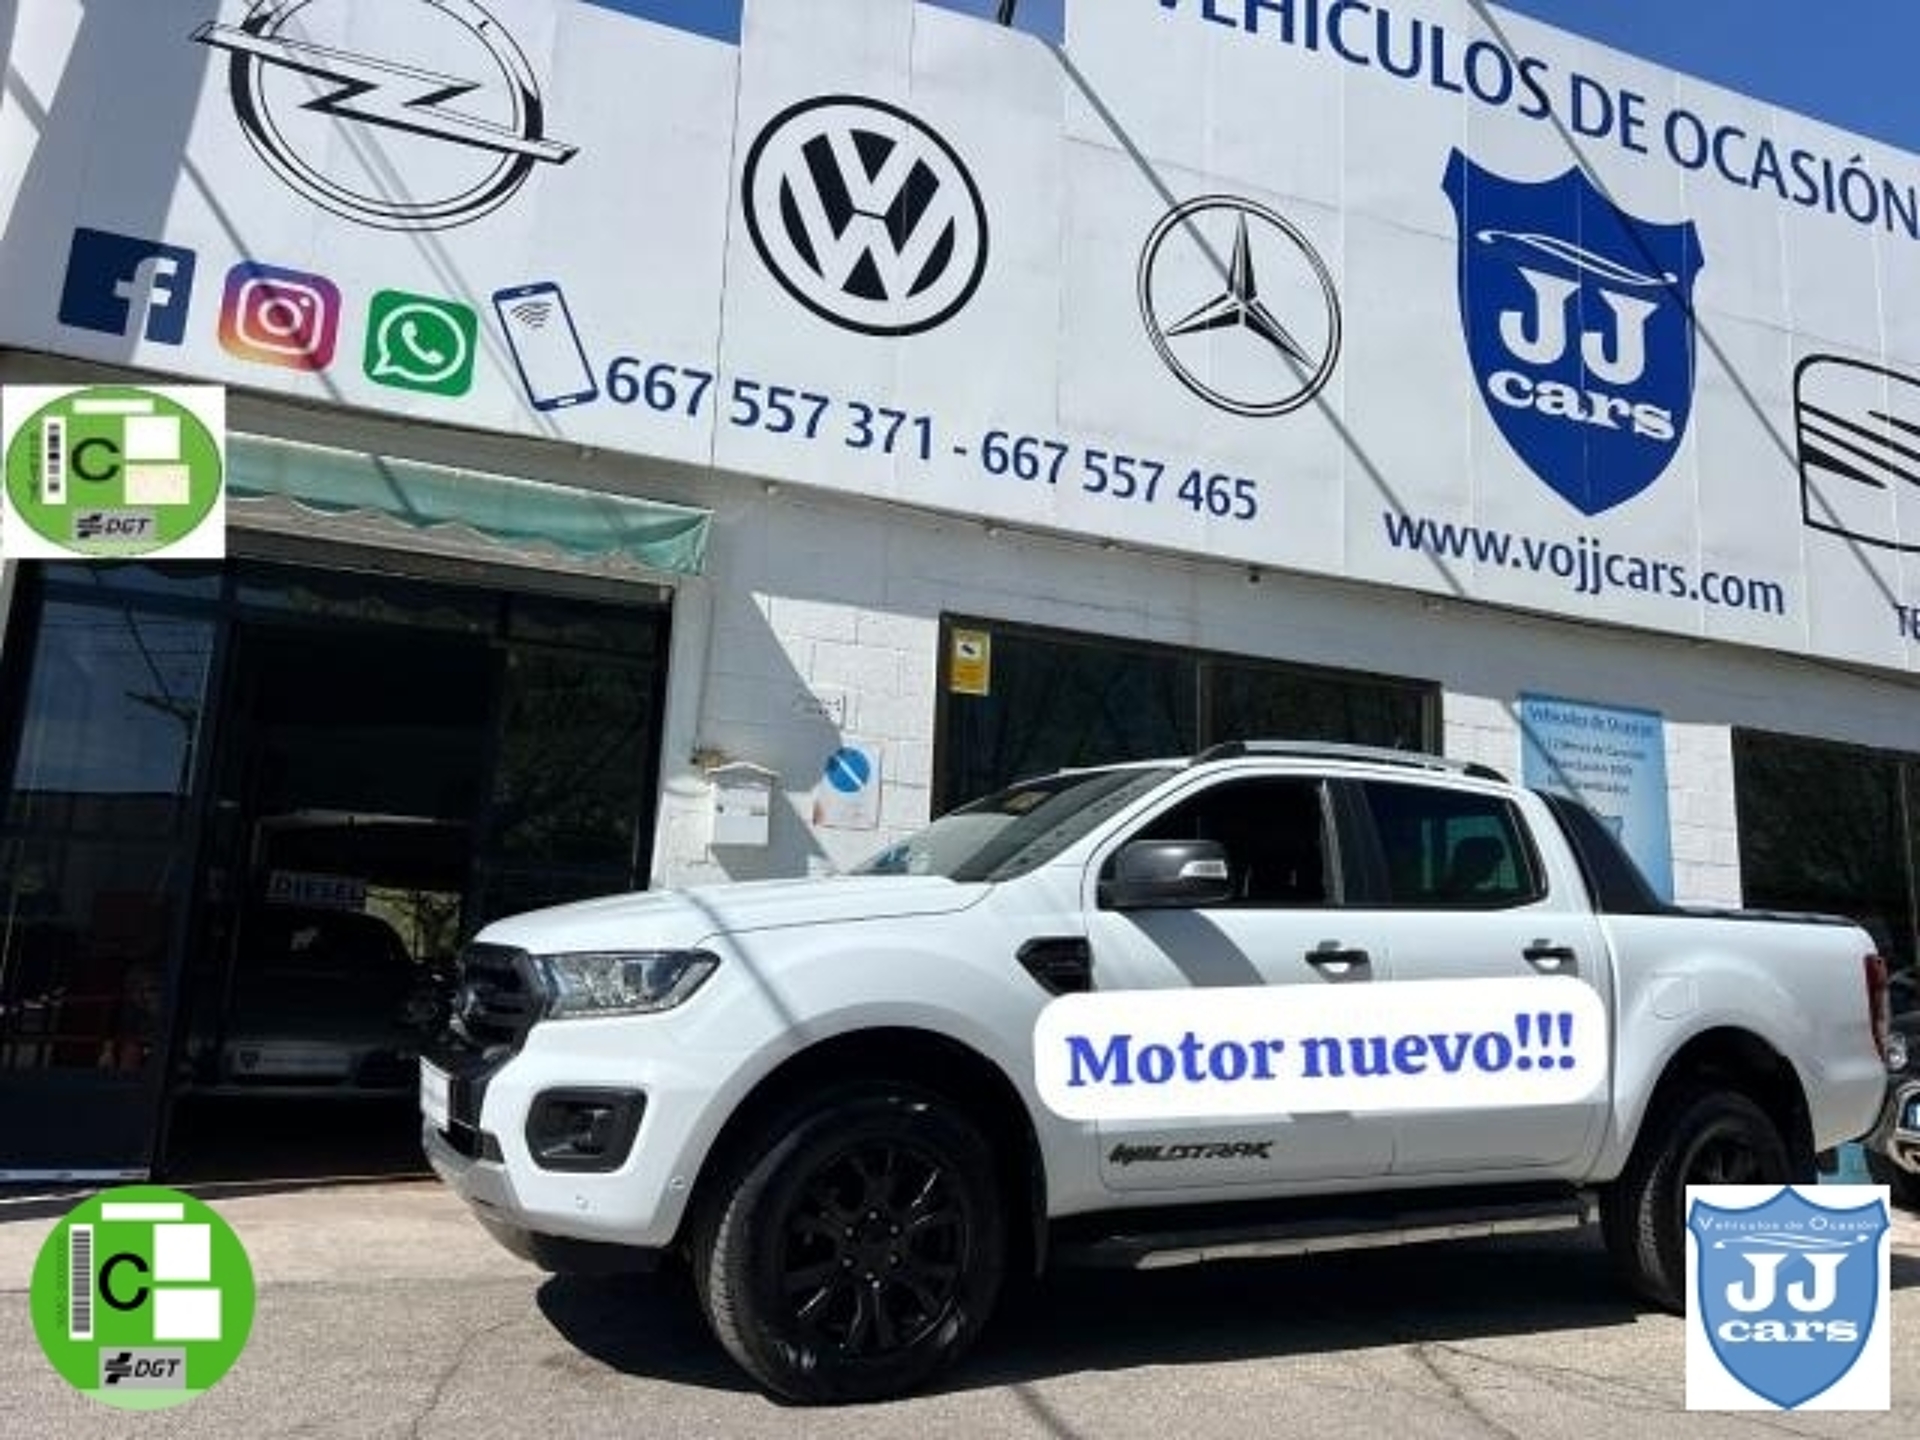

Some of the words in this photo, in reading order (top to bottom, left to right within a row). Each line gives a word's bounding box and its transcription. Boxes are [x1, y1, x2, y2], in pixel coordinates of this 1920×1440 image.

[1160, 0, 1548, 120] HICULOS
[1570, 71, 1648, 154] DE
[1664, 108, 1920, 240] OCASIÓN
[1500, 266, 1660, 385] JJ
[605, 356, 713, 417] 667
[729, 377, 829, 440] 557
[844, 401, 932, 460] 371
[982, 430, 1069, 484] 667
[1082, 449, 1165, 502] 557
[1177, 468, 1258, 520] 465
[1487, 370, 1675, 441] cars
[1384, 511, 1786, 616] www.vojjcars.com
